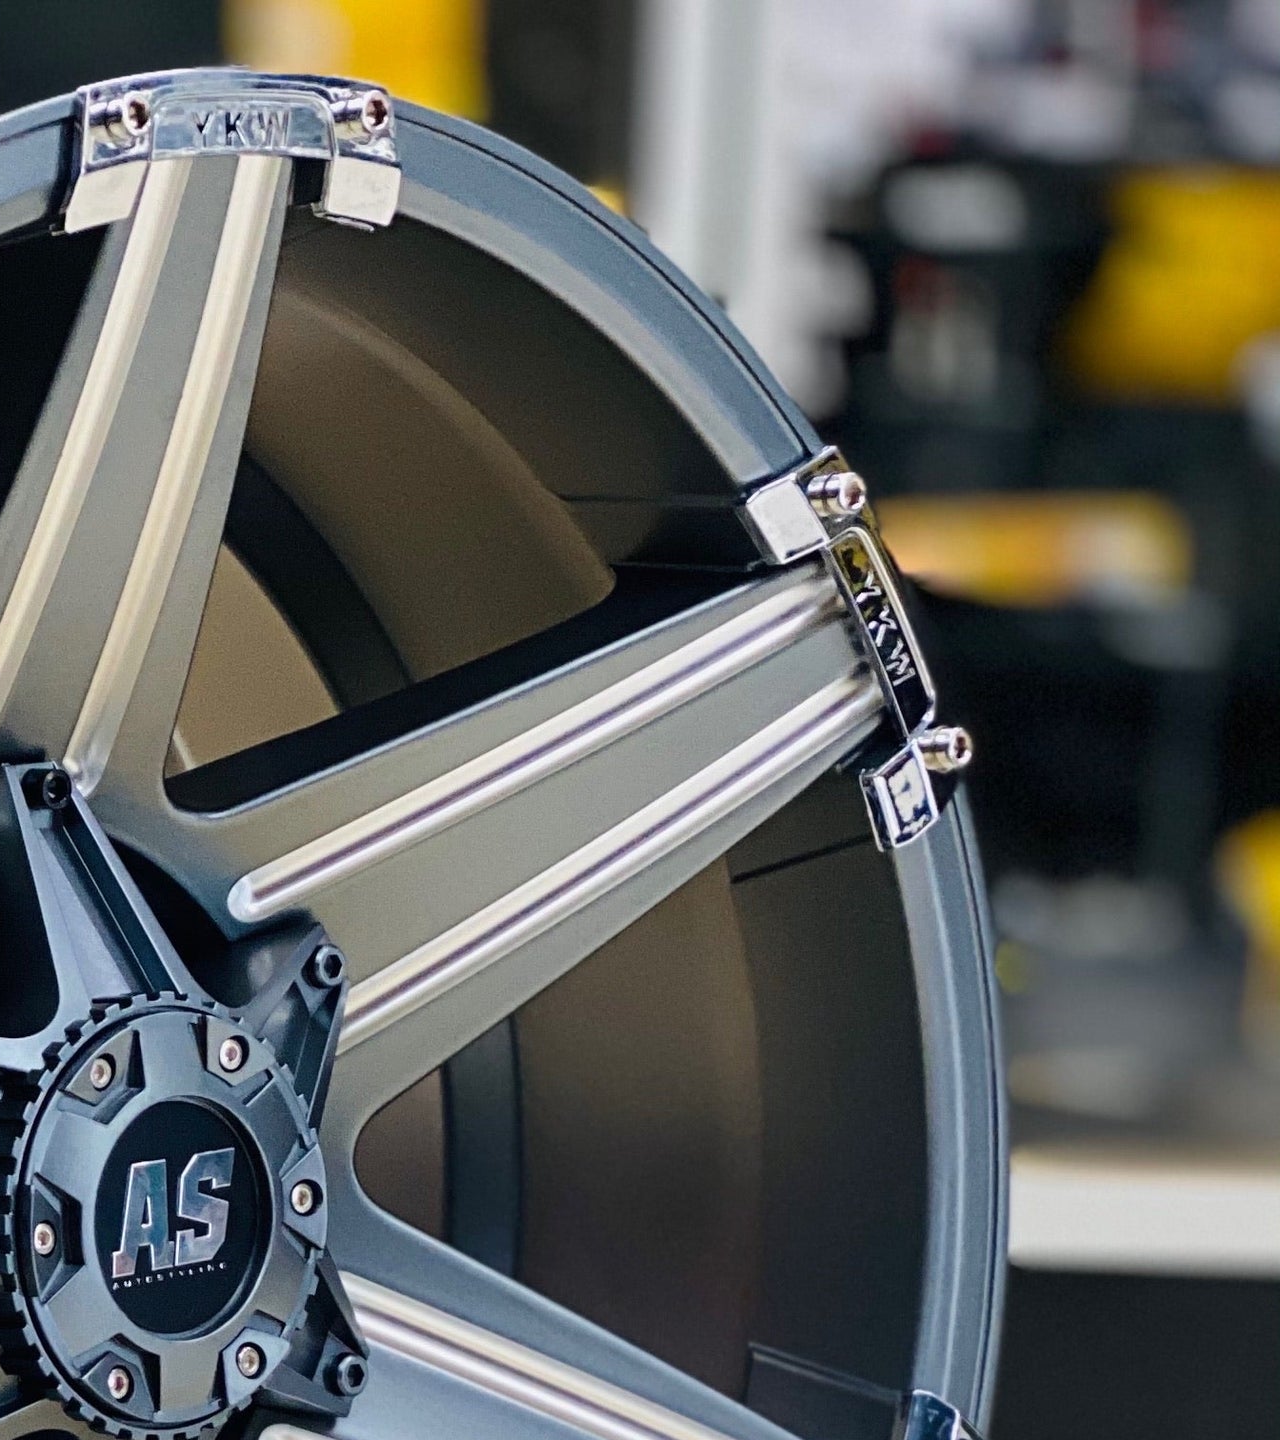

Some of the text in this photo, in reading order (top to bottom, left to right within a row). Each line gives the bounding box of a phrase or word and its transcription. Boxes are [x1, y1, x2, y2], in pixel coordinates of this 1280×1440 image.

[192, 109, 290, 148] YKW
[855, 571, 917, 687] YKW
[112, 1147, 235, 1278] AS
